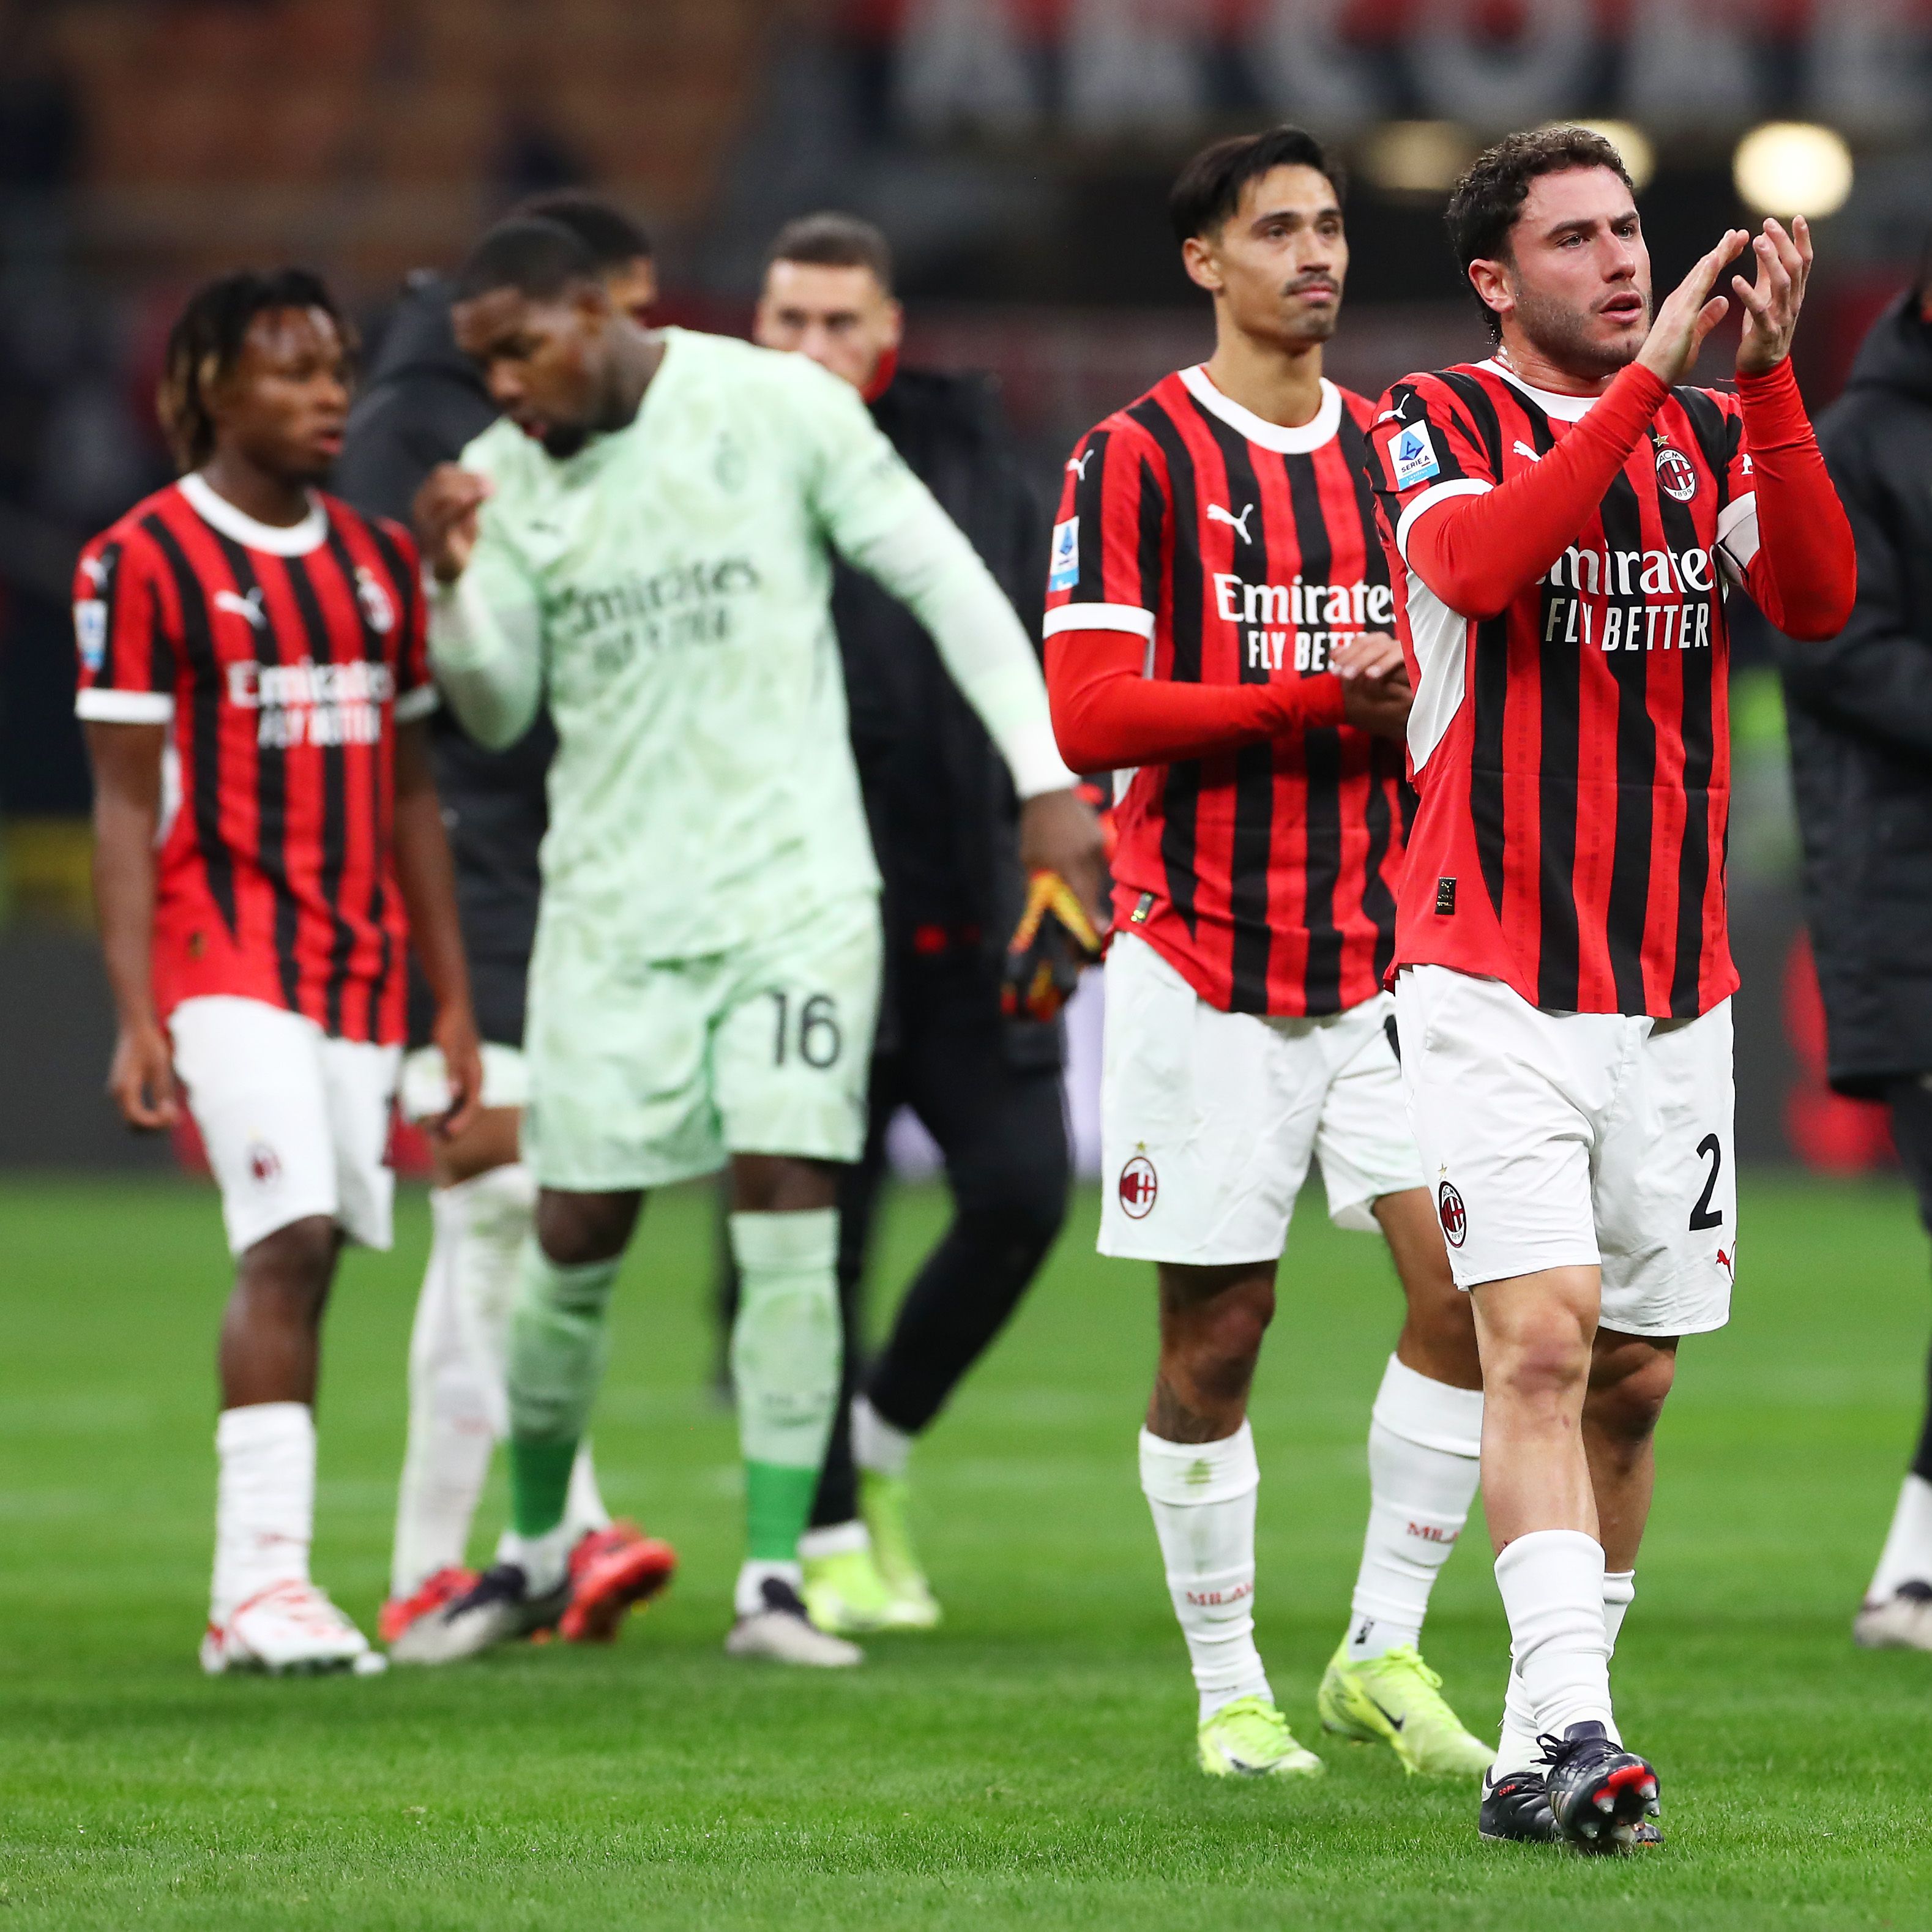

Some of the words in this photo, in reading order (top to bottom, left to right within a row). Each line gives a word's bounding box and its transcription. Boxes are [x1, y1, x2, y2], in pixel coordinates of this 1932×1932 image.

[1401, 458, 1422, 472] SERIE
[1659, 451, 1681, 464] ACM
[1535, 539, 1718, 595] mirate
[1247, 630, 1286, 669] FLY
[1545, 598, 1593, 644] FLY
[1601, 603, 1709, 651] BETTER
[765, 991, 841, 1069] 16
[1688, 1133, 1723, 1231] 2
